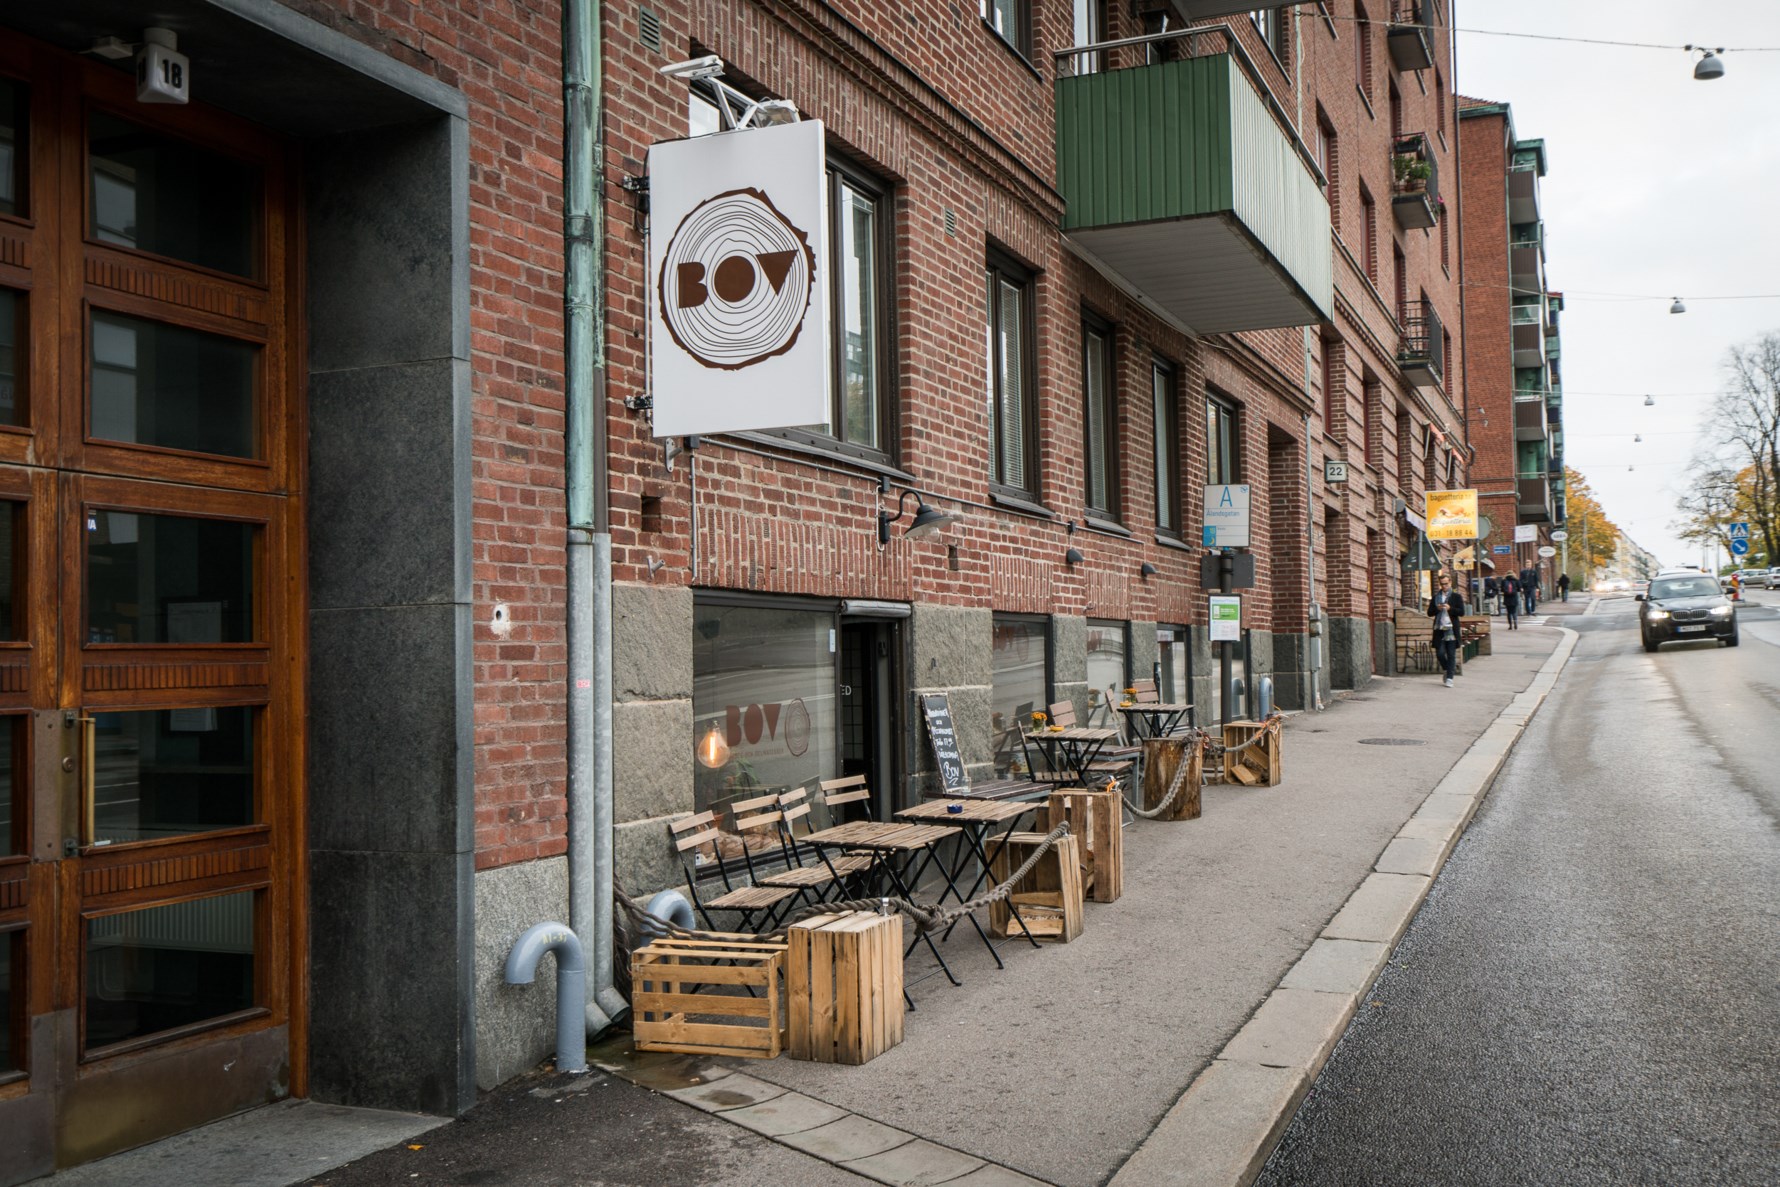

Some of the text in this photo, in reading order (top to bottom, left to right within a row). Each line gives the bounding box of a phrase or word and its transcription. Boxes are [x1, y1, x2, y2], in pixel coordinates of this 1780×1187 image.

[162, 59, 182, 89] 18
[677, 249, 799, 309] BOV
[1329, 466, 1343, 476] 22
[1219, 486, 1233, 508] A
[726, 703, 782, 747] BOV
